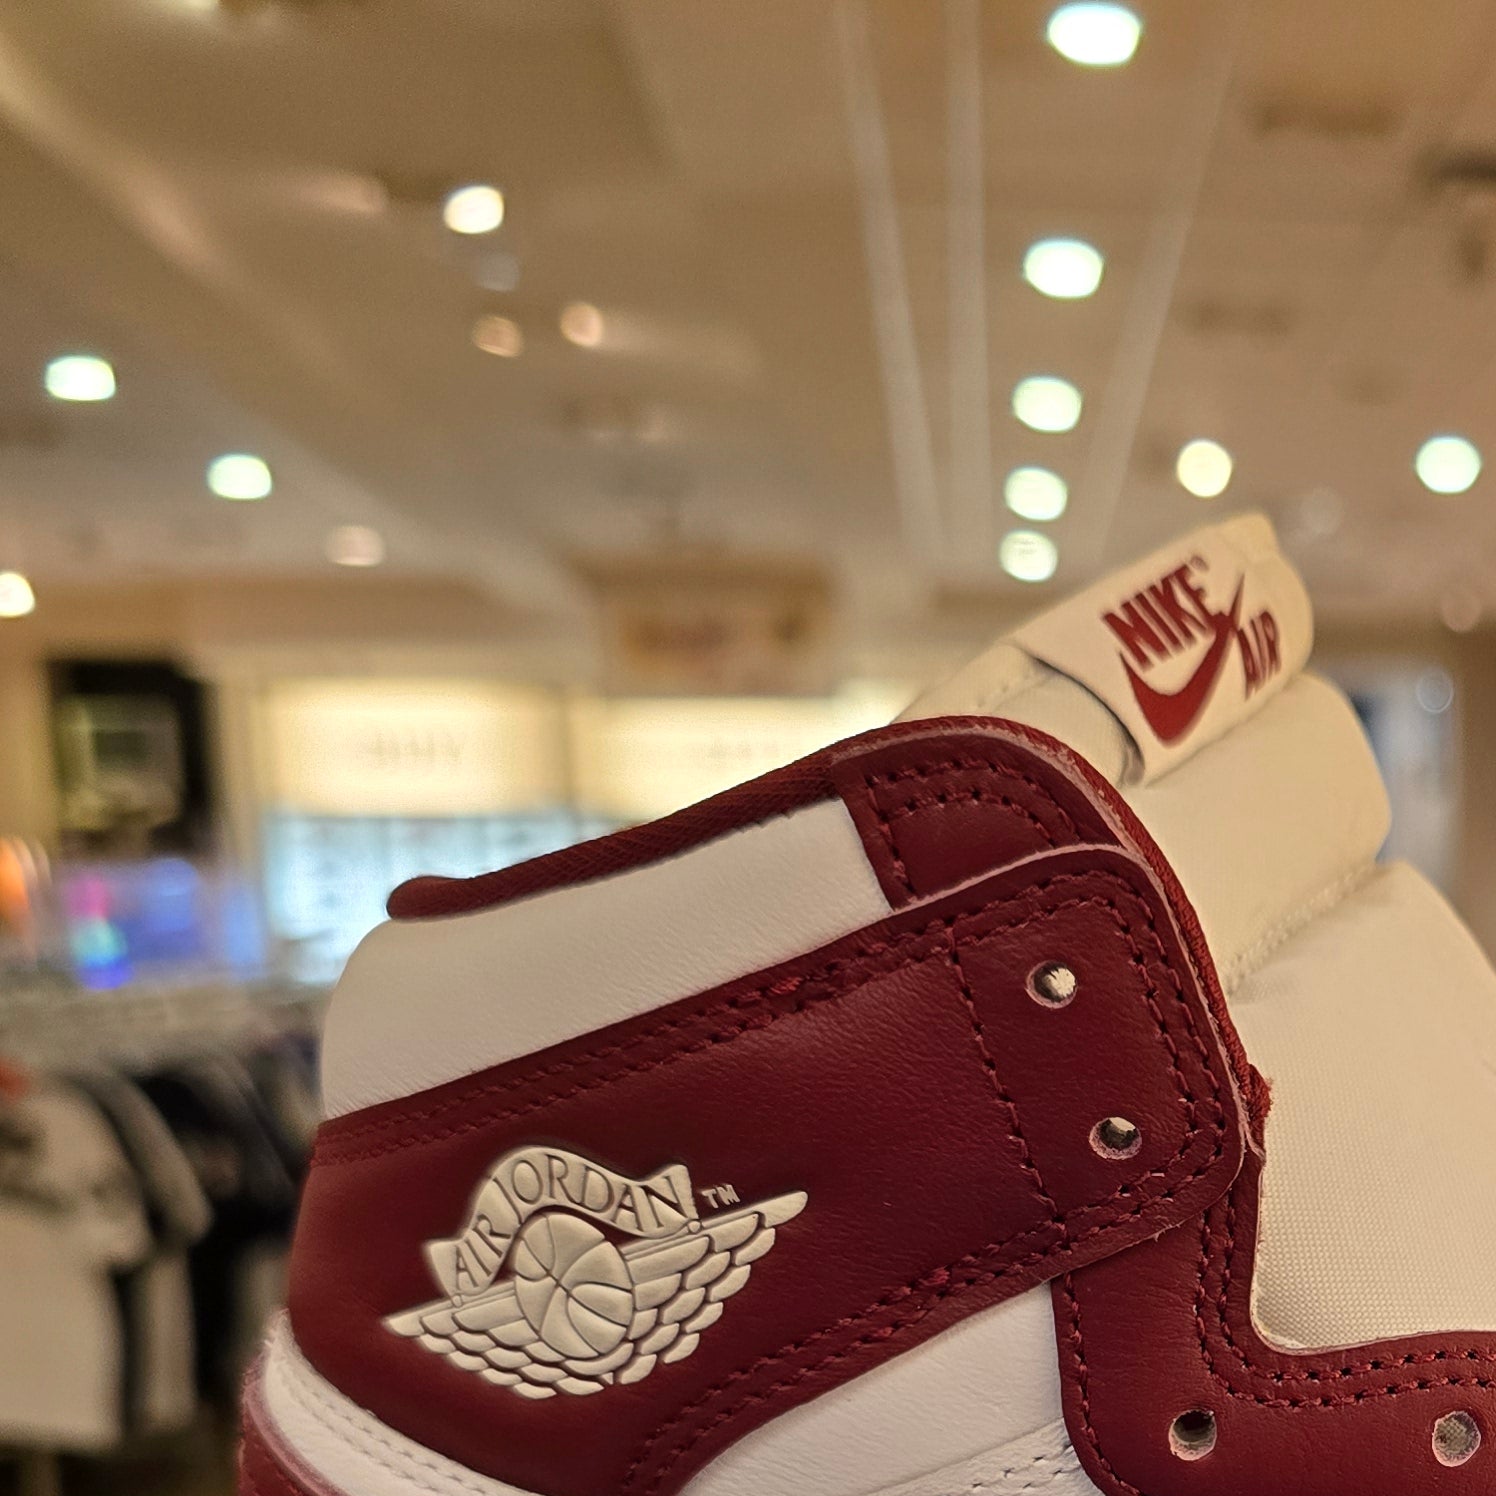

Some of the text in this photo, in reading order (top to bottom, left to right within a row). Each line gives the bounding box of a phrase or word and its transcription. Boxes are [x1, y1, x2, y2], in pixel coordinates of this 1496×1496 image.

[1102, 563, 1226, 672] NIKE
[1237, 610, 1282, 700] AIR
[453, 1213, 513, 1290] AIR
[493, 1153, 696, 1230] JORDAN
